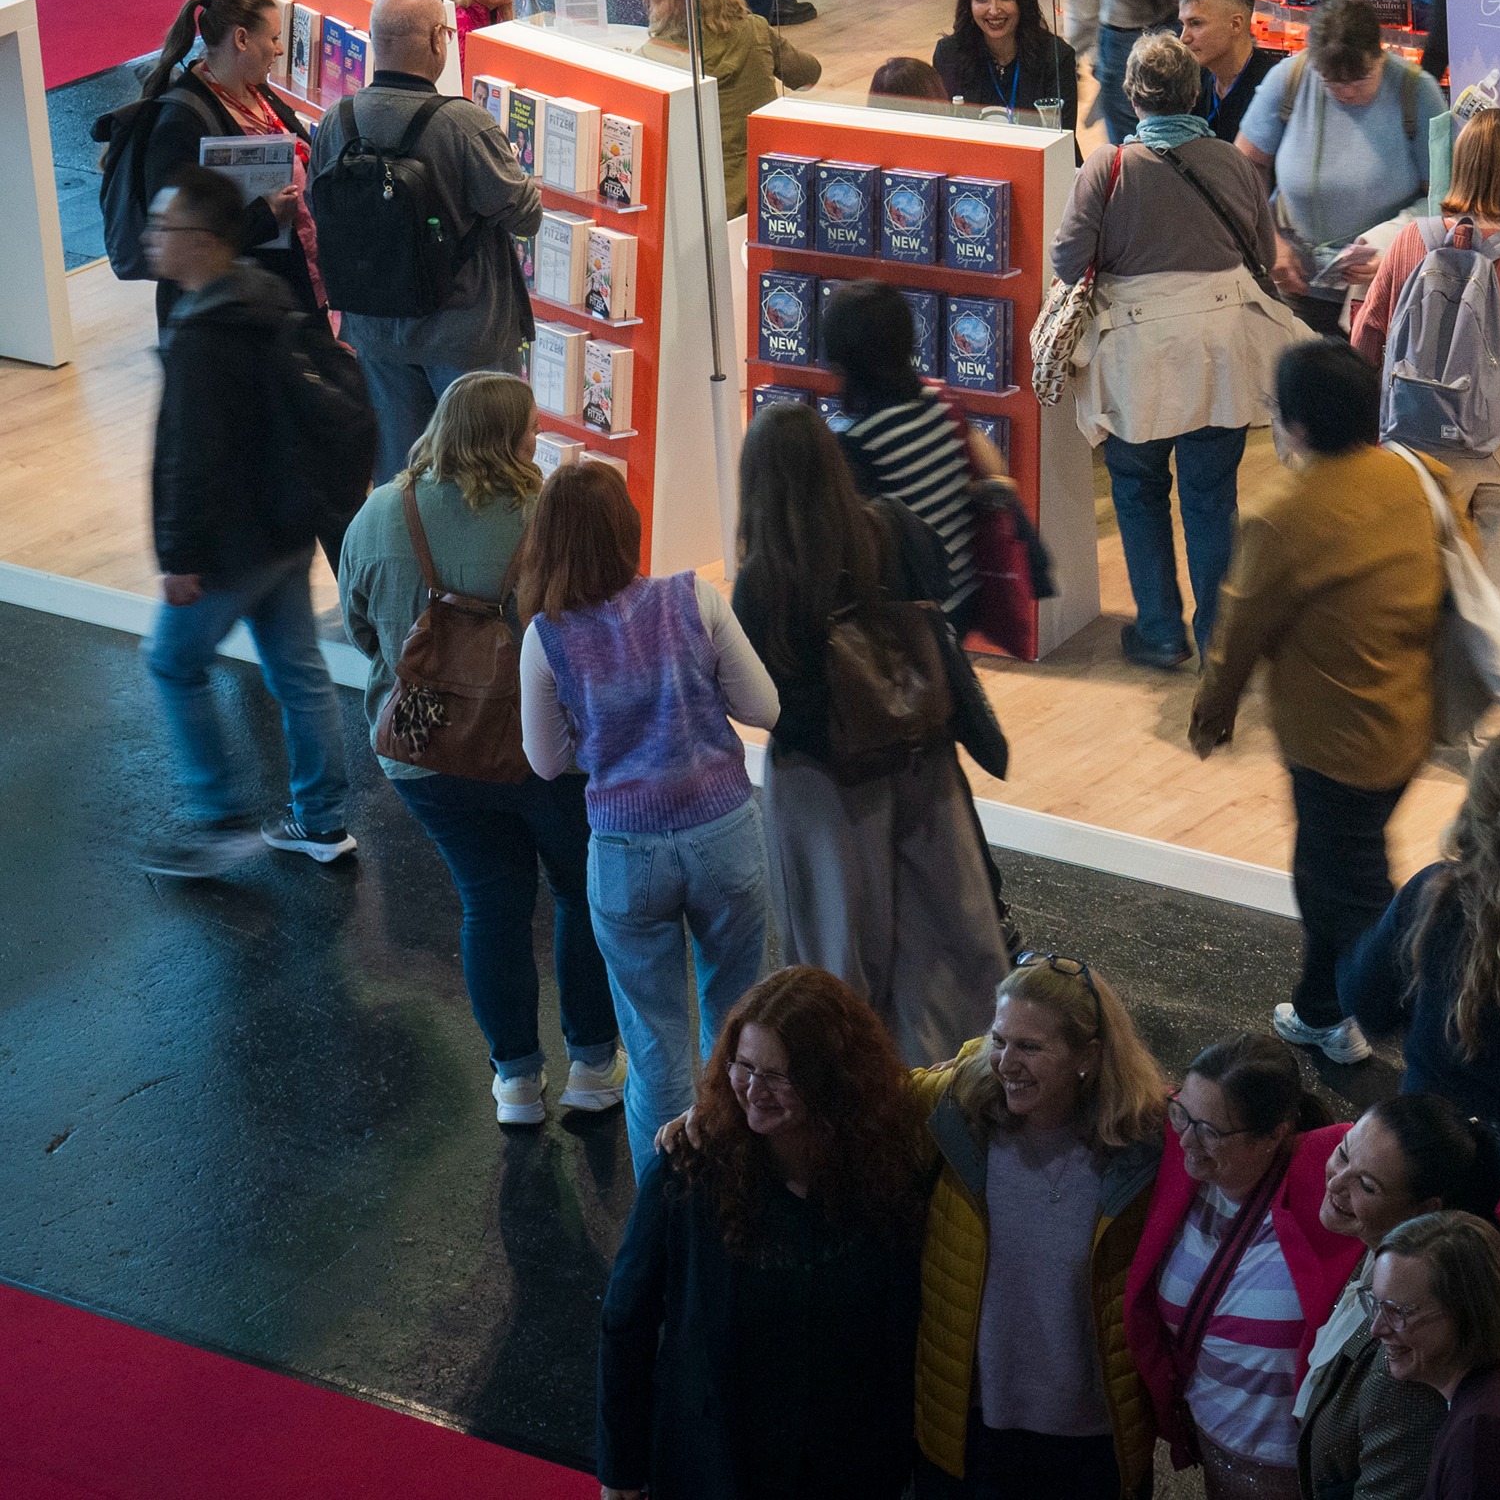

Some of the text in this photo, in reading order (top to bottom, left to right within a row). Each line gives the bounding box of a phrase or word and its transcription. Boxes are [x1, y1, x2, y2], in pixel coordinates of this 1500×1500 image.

[550, 115, 575, 133] FITZEK
[603, 182, 625, 198] FITZEK
[768, 219, 797, 234] NEW
[827, 227, 858, 242] NEW
[891, 234, 921, 250] NEW
[956, 243, 986, 258] NEW
[538, 337, 564, 357] FITZEK
[769, 336, 798, 351] NEW
[957, 361, 986, 376] NEW
[586, 407, 607, 424] FITZEK
